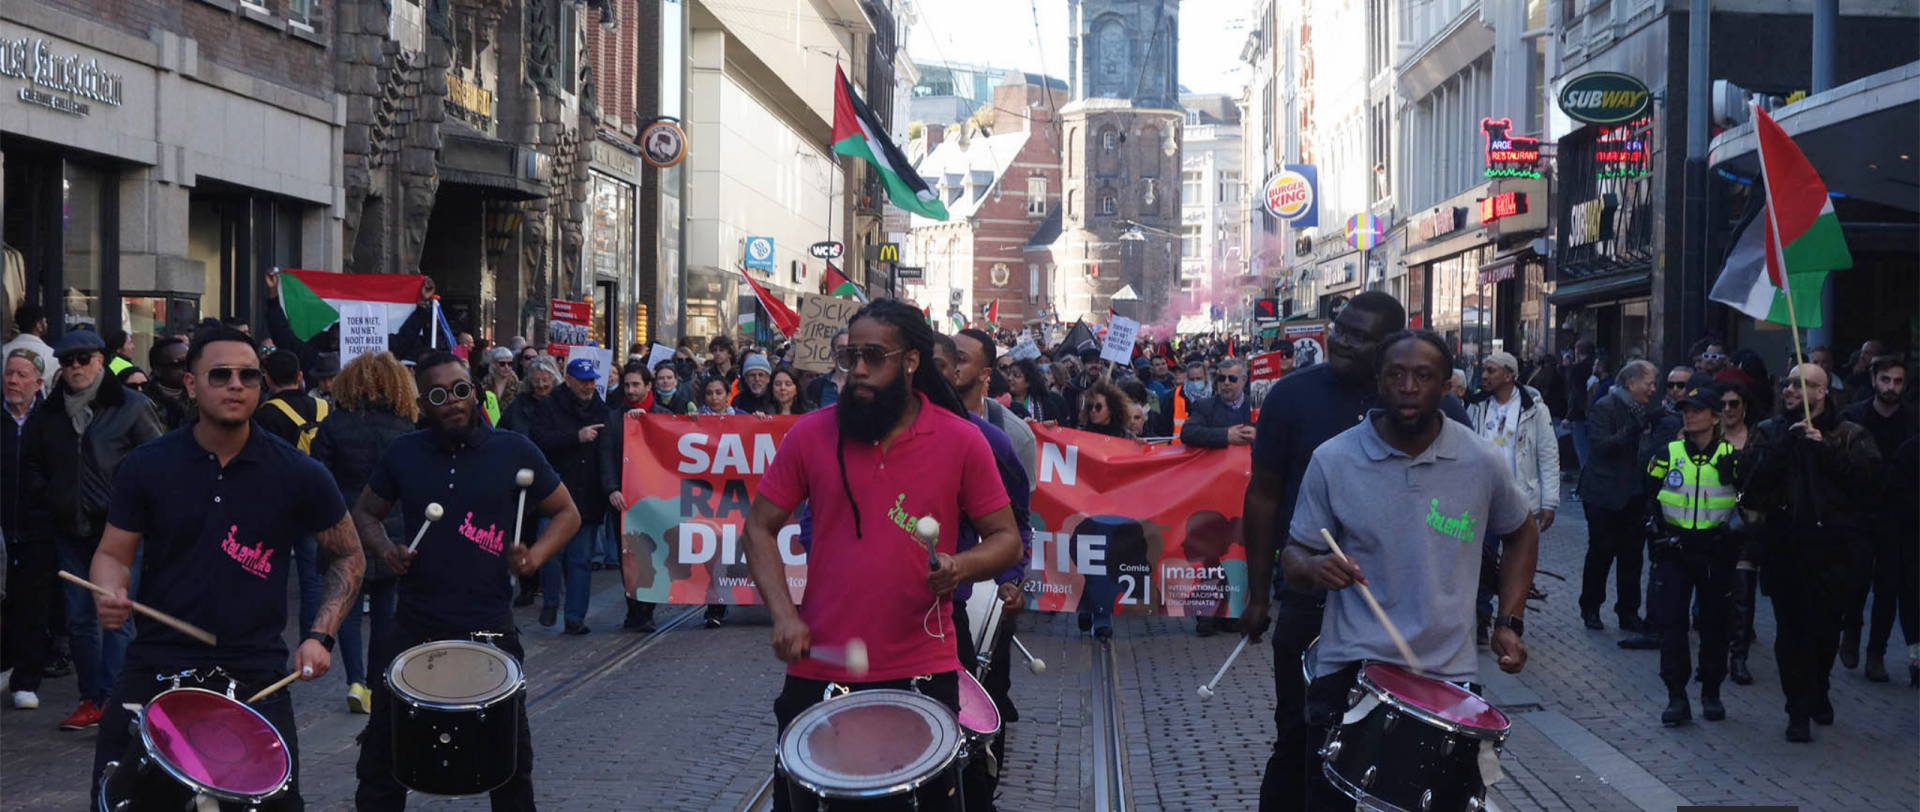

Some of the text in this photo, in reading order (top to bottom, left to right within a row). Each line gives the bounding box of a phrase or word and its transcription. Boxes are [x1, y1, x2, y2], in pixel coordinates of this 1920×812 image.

[1563, 89, 1648, 109] SUBWAY
[1491, 150, 1538, 161] RESTAURANT
[1268, 181, 1305, 199] BURGER
[1270, 189, 1306, 210] KING
[1568, 198, 1605, 248] SUBWAY
[806, 296, 852, 324] SICK
[347, 316, 381, 326] TOEN NIET,
[344, 336, 384, 345] NOOIT MEER
[350, 327, 377, 336] NU NIET,
[1040, 441, 1079, 486] N
[678, 522, 1107, 576] DIC TIE
[1119, 563, 1150, 572] Comité
[1117, 565, 1226, 605] 21 maart
[1168, 584, 1225, 592] INTERNATIONALE
